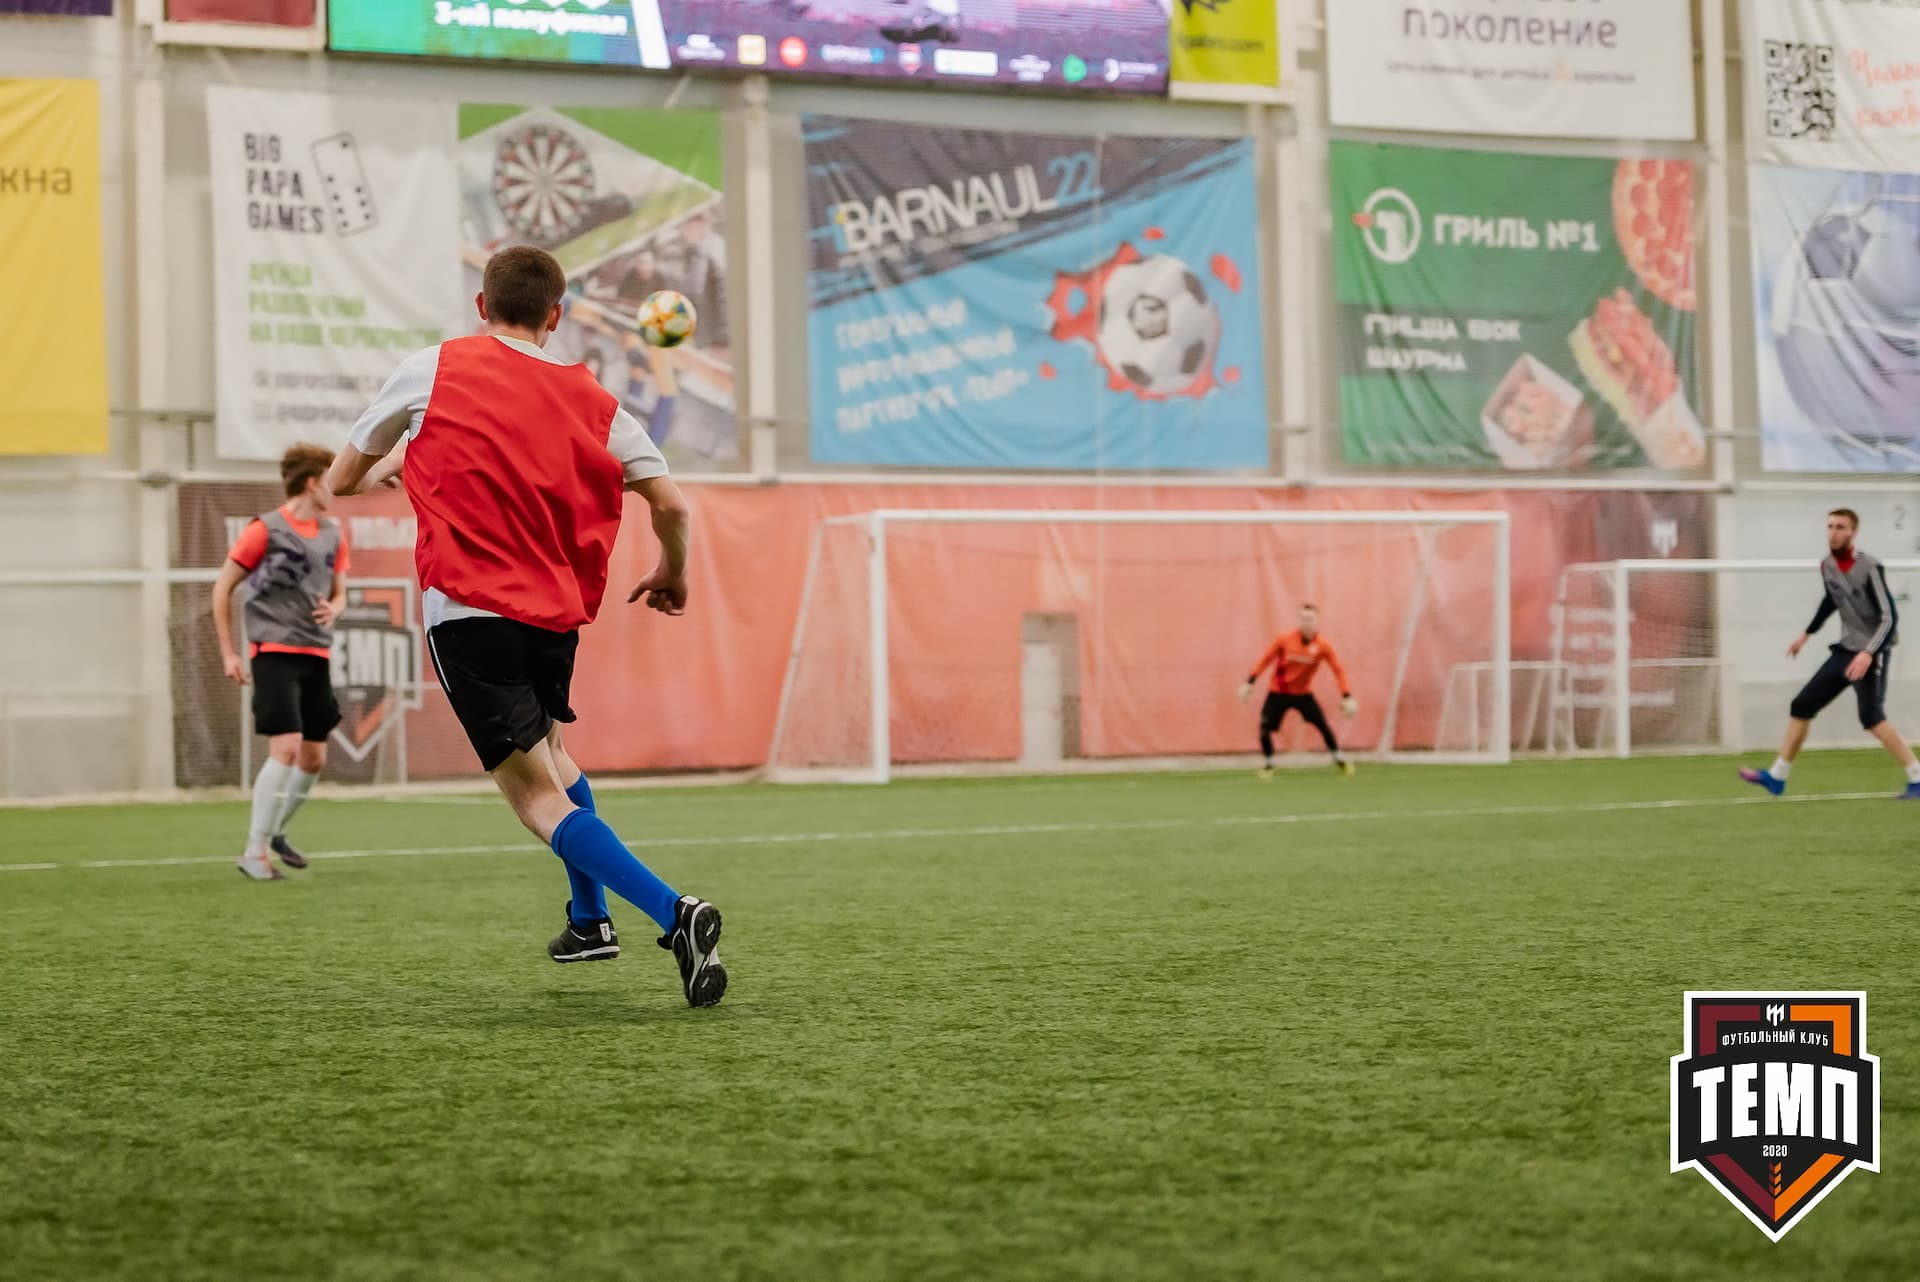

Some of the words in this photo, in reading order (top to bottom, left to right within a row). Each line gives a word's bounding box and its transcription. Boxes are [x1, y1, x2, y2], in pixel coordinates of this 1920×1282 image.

[1403, 9, 1617, 49] поколение
[244, 133, 281, 163] BIG
[246, 170, 304, 198] PAPA
[248, 202, 325, 235] GAMES
[1433, 214, 1539, 249] ГРИЛЬ
[1545, 219, 1599, 251] №1
